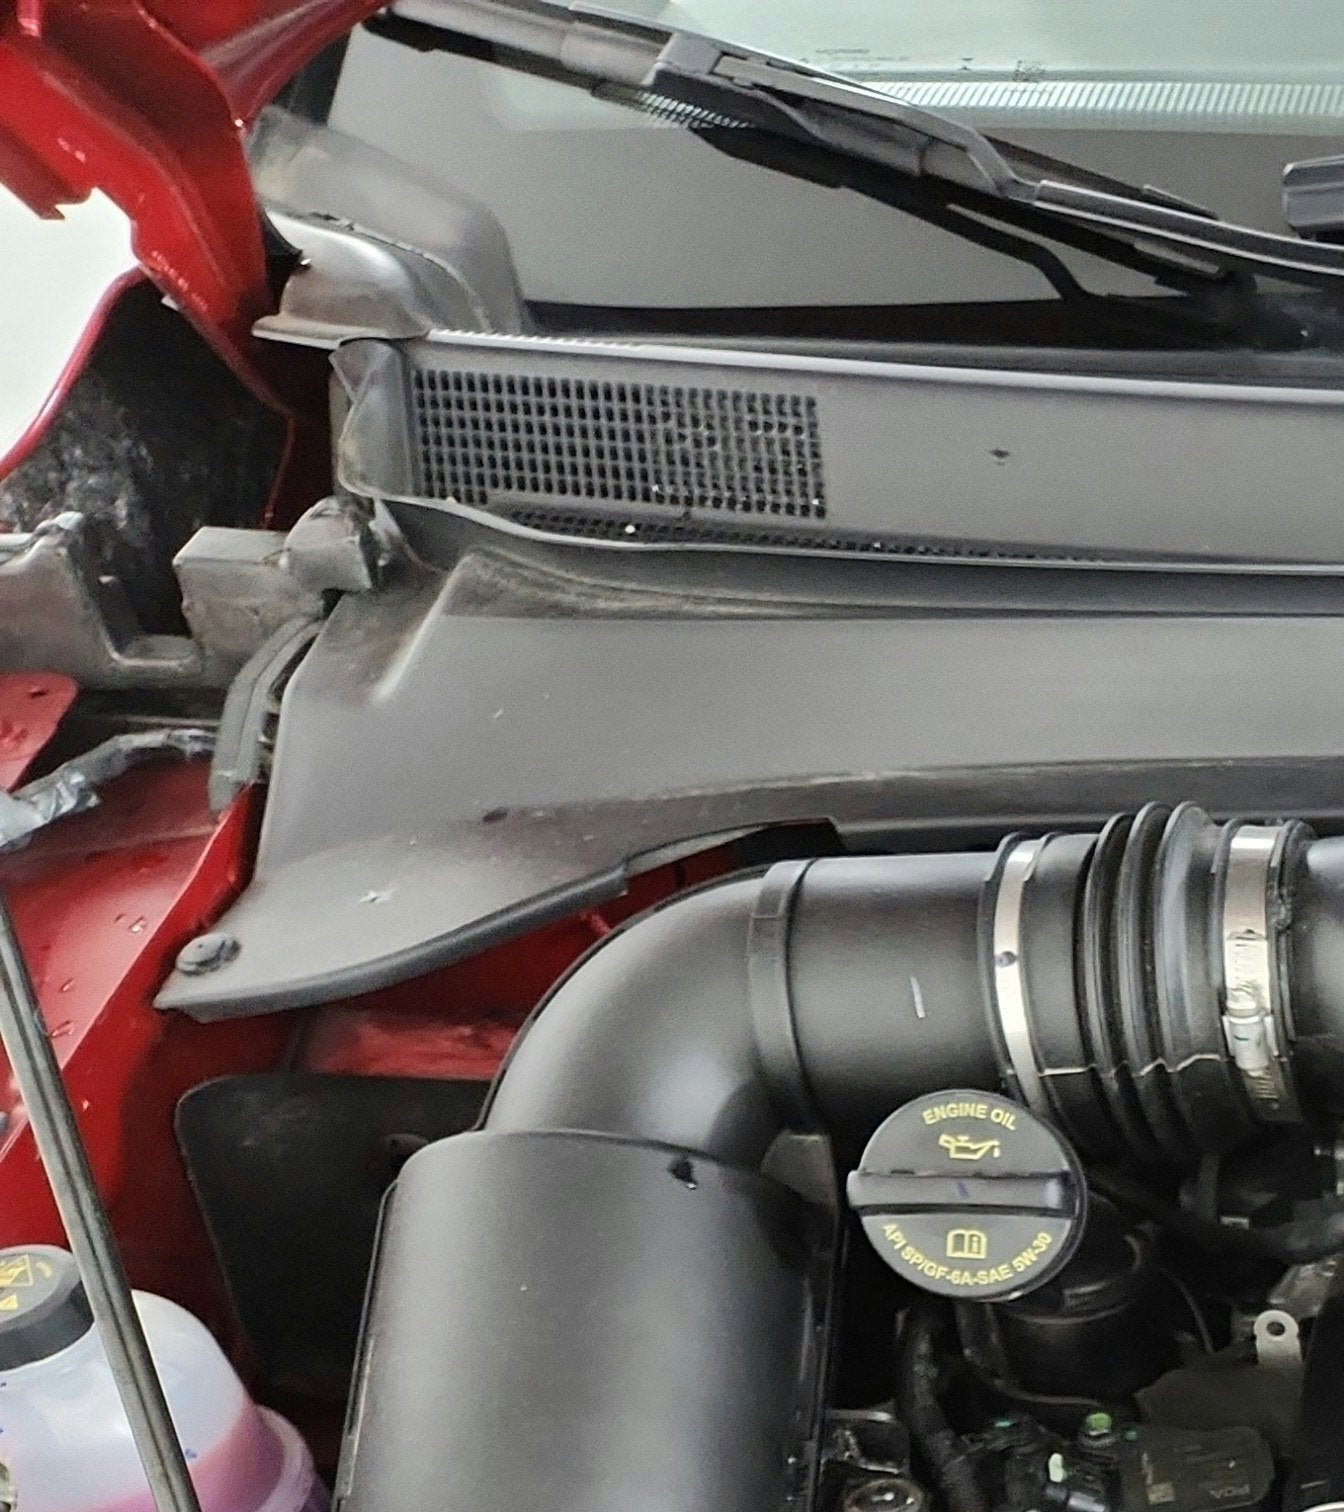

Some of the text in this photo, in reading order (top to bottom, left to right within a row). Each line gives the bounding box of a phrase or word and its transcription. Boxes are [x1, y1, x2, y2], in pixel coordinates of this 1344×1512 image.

[922, 1103, 1017, 1130] ENGINE OIL
[882, 1223, 907, 1251] API
[1012, 1232, 1053, 1273] 5W-30
